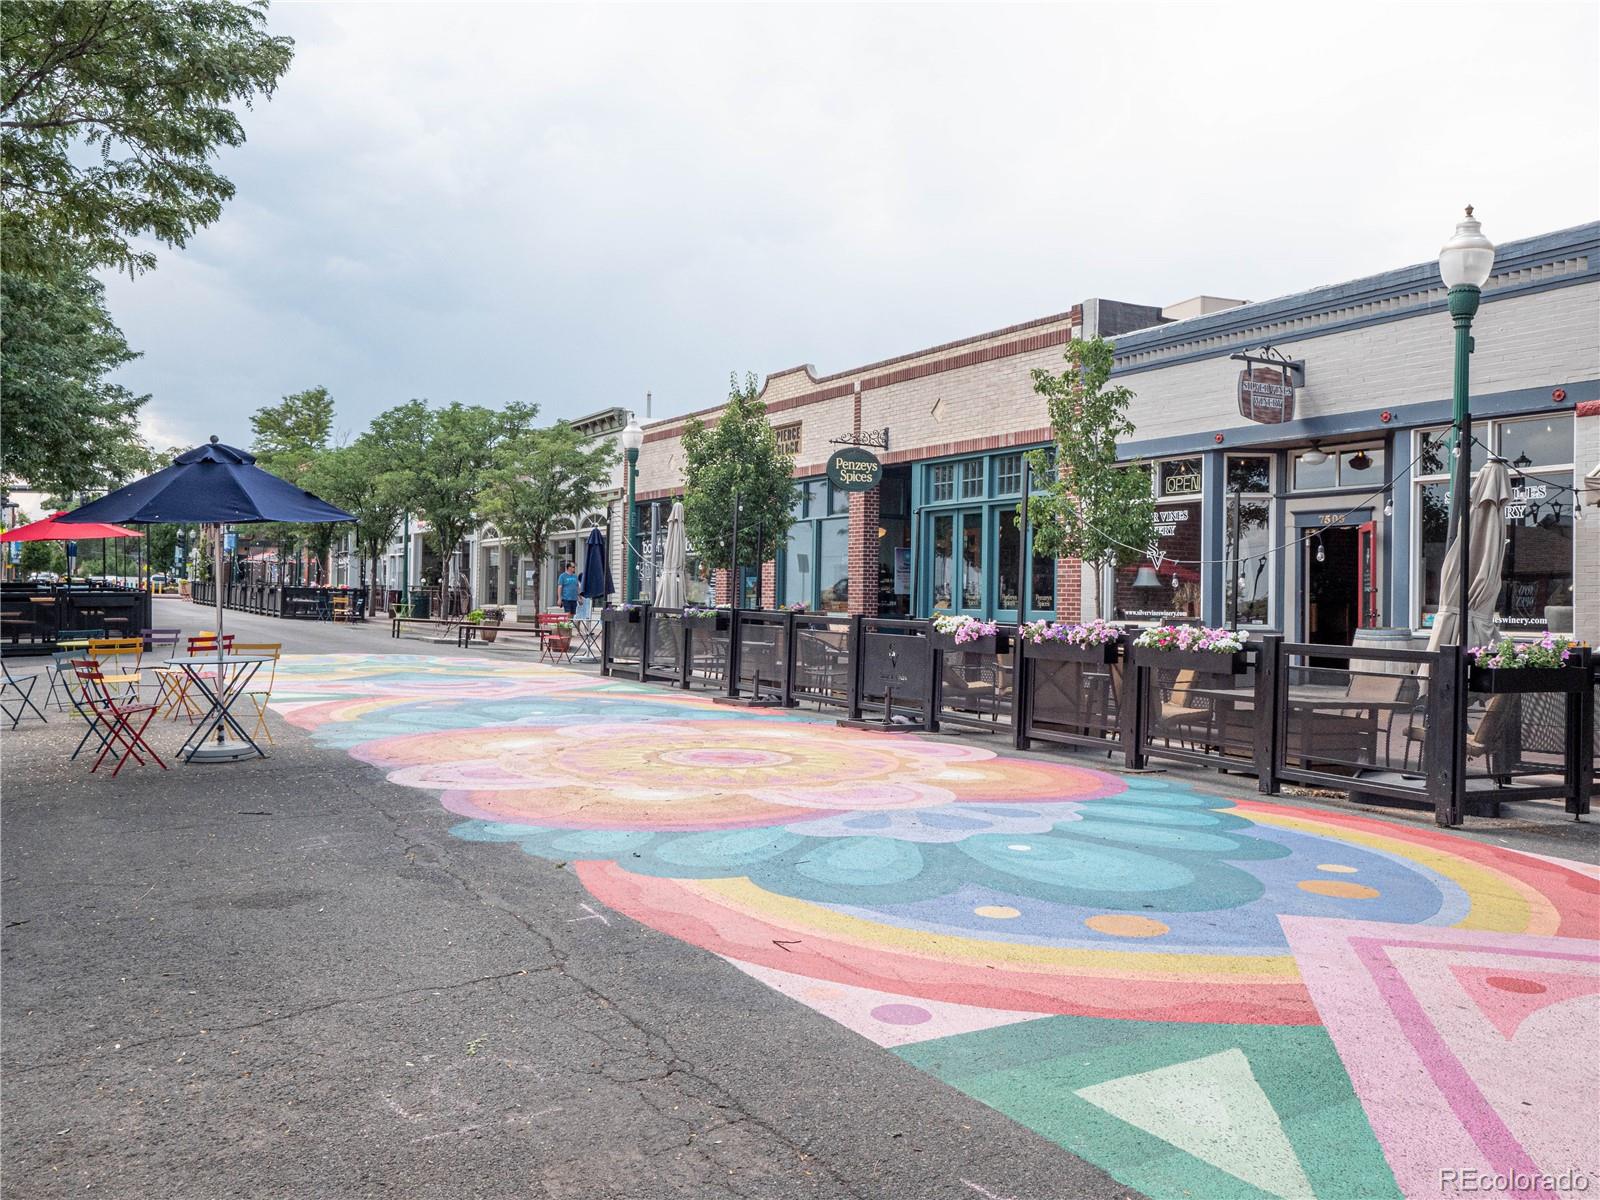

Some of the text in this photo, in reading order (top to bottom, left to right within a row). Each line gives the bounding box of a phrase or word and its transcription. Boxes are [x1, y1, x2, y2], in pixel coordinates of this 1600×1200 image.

[776, 427, 801, 442] PIERCE
[836, 457, 878, 474] Penzeys
[840, 470, 873, 484] Spices
[1167, 476, 1199, 492] OPEN
[1160, 510, 1189, 521] VINES
